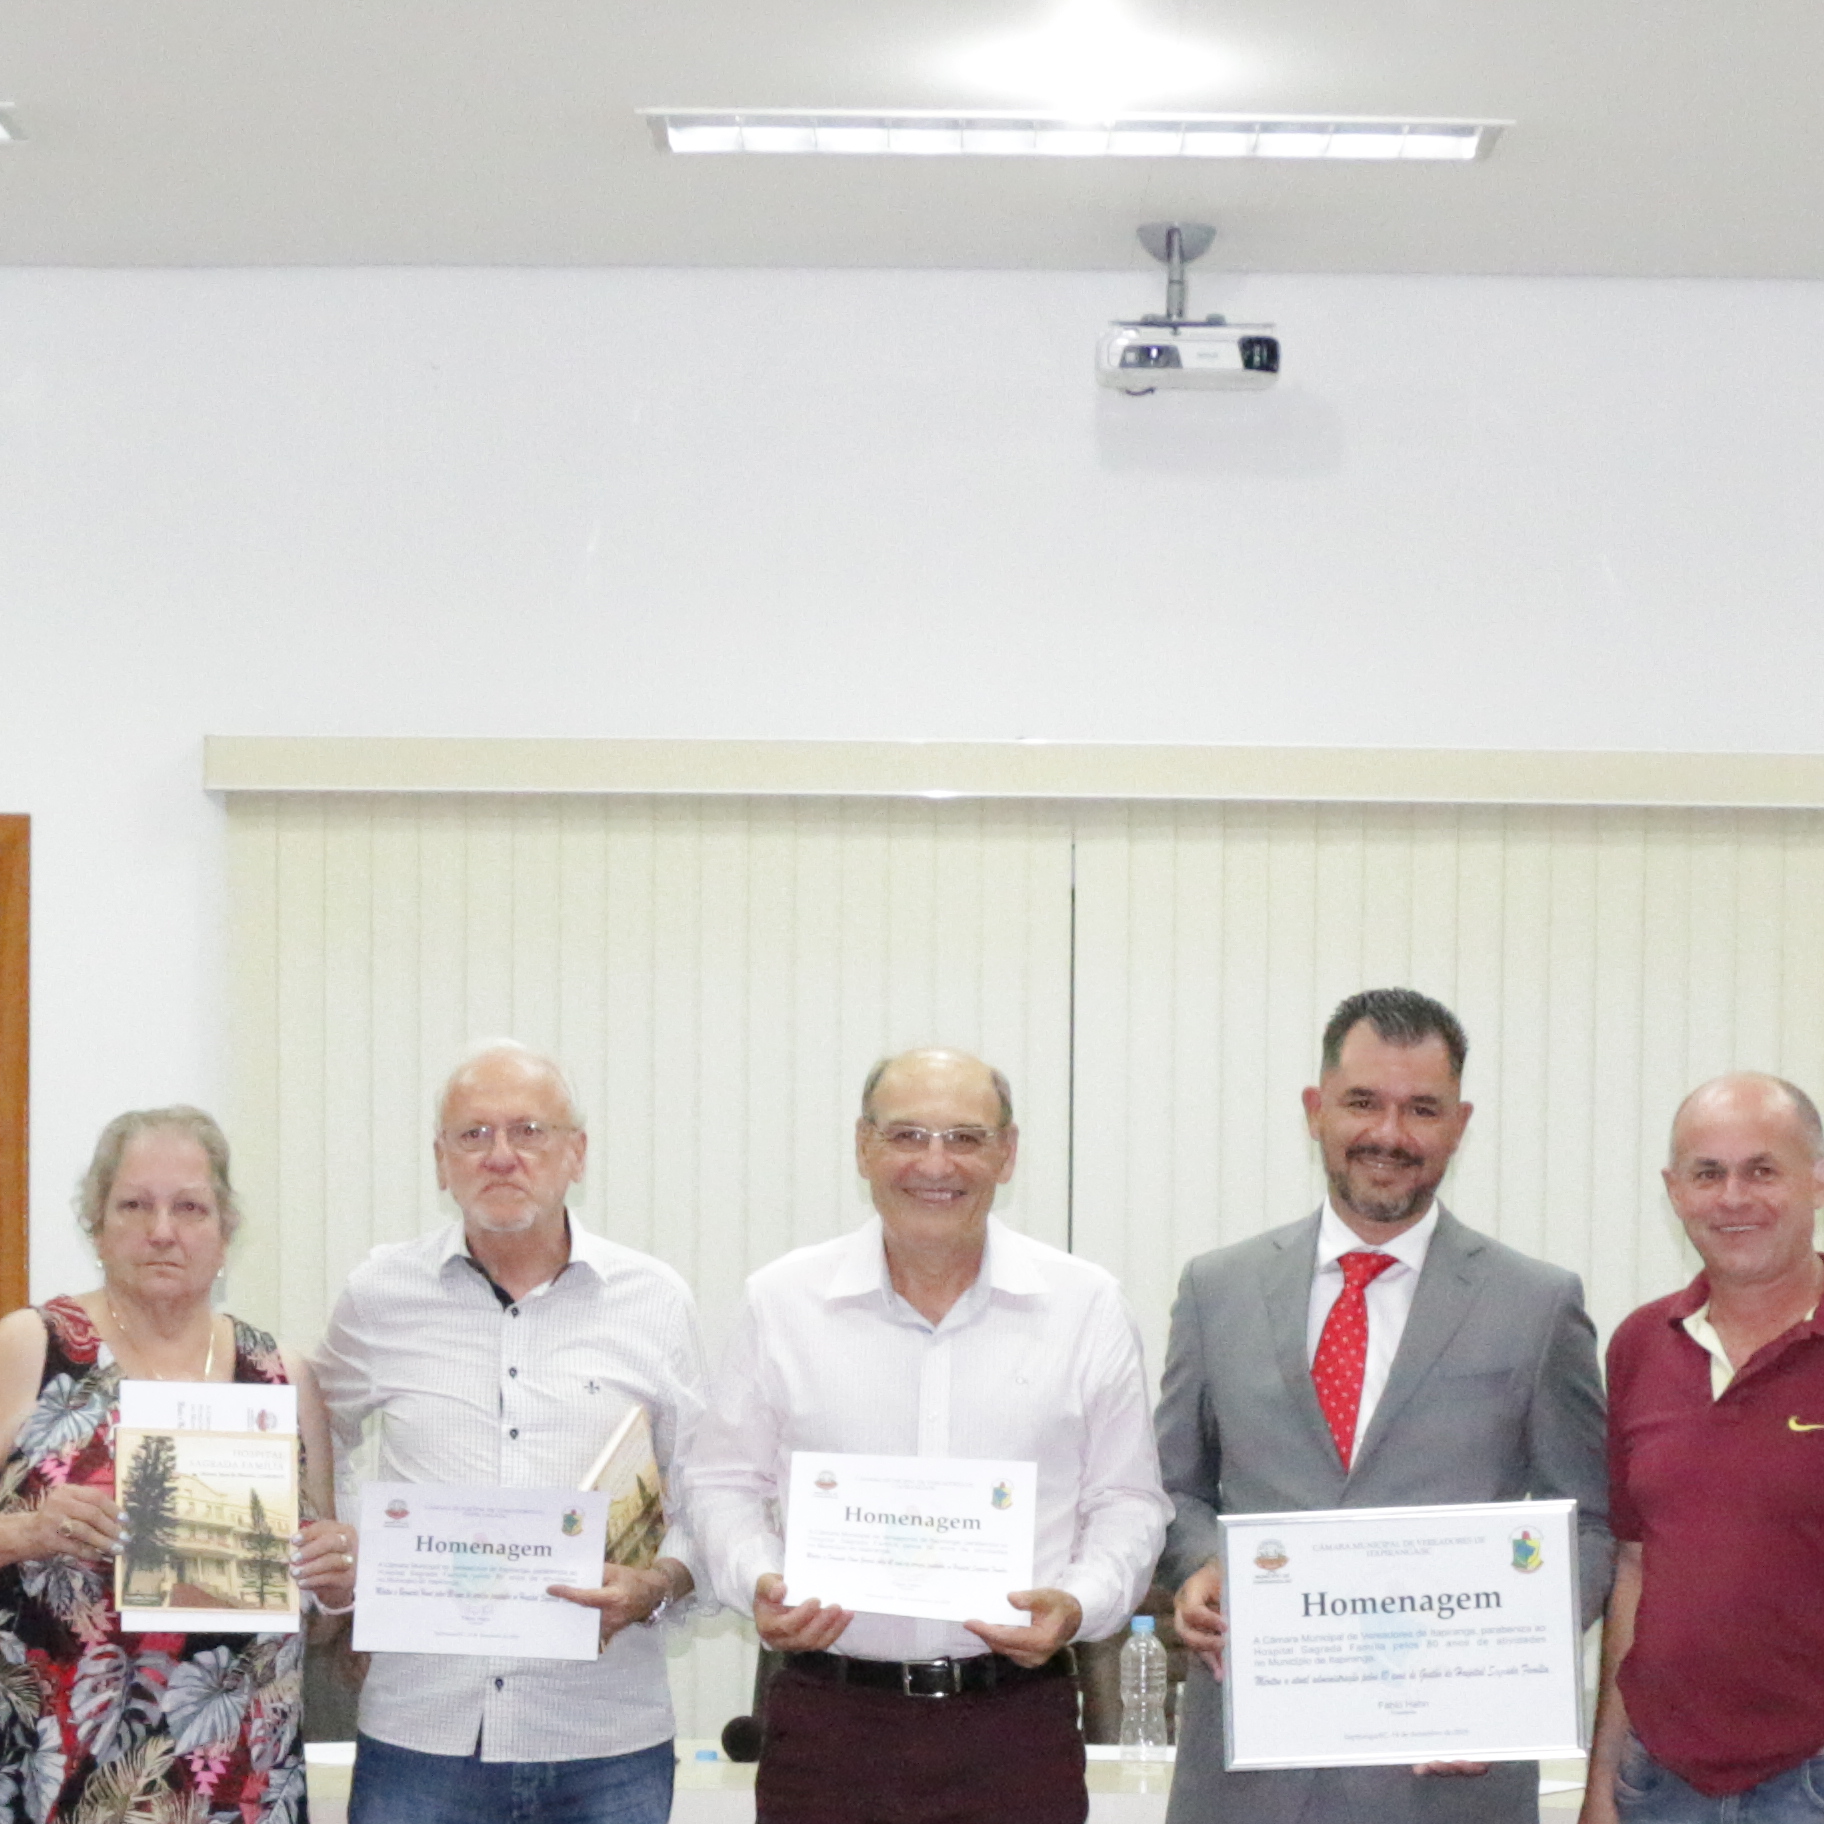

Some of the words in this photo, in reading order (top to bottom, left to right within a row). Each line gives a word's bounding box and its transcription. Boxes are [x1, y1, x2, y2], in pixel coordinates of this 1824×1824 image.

[844, 1505, 981, 1533] Homenagem
[414, 1535, 552, 1561] Homenagem
[1301, 1590, 1503, 1620] Homenagem
